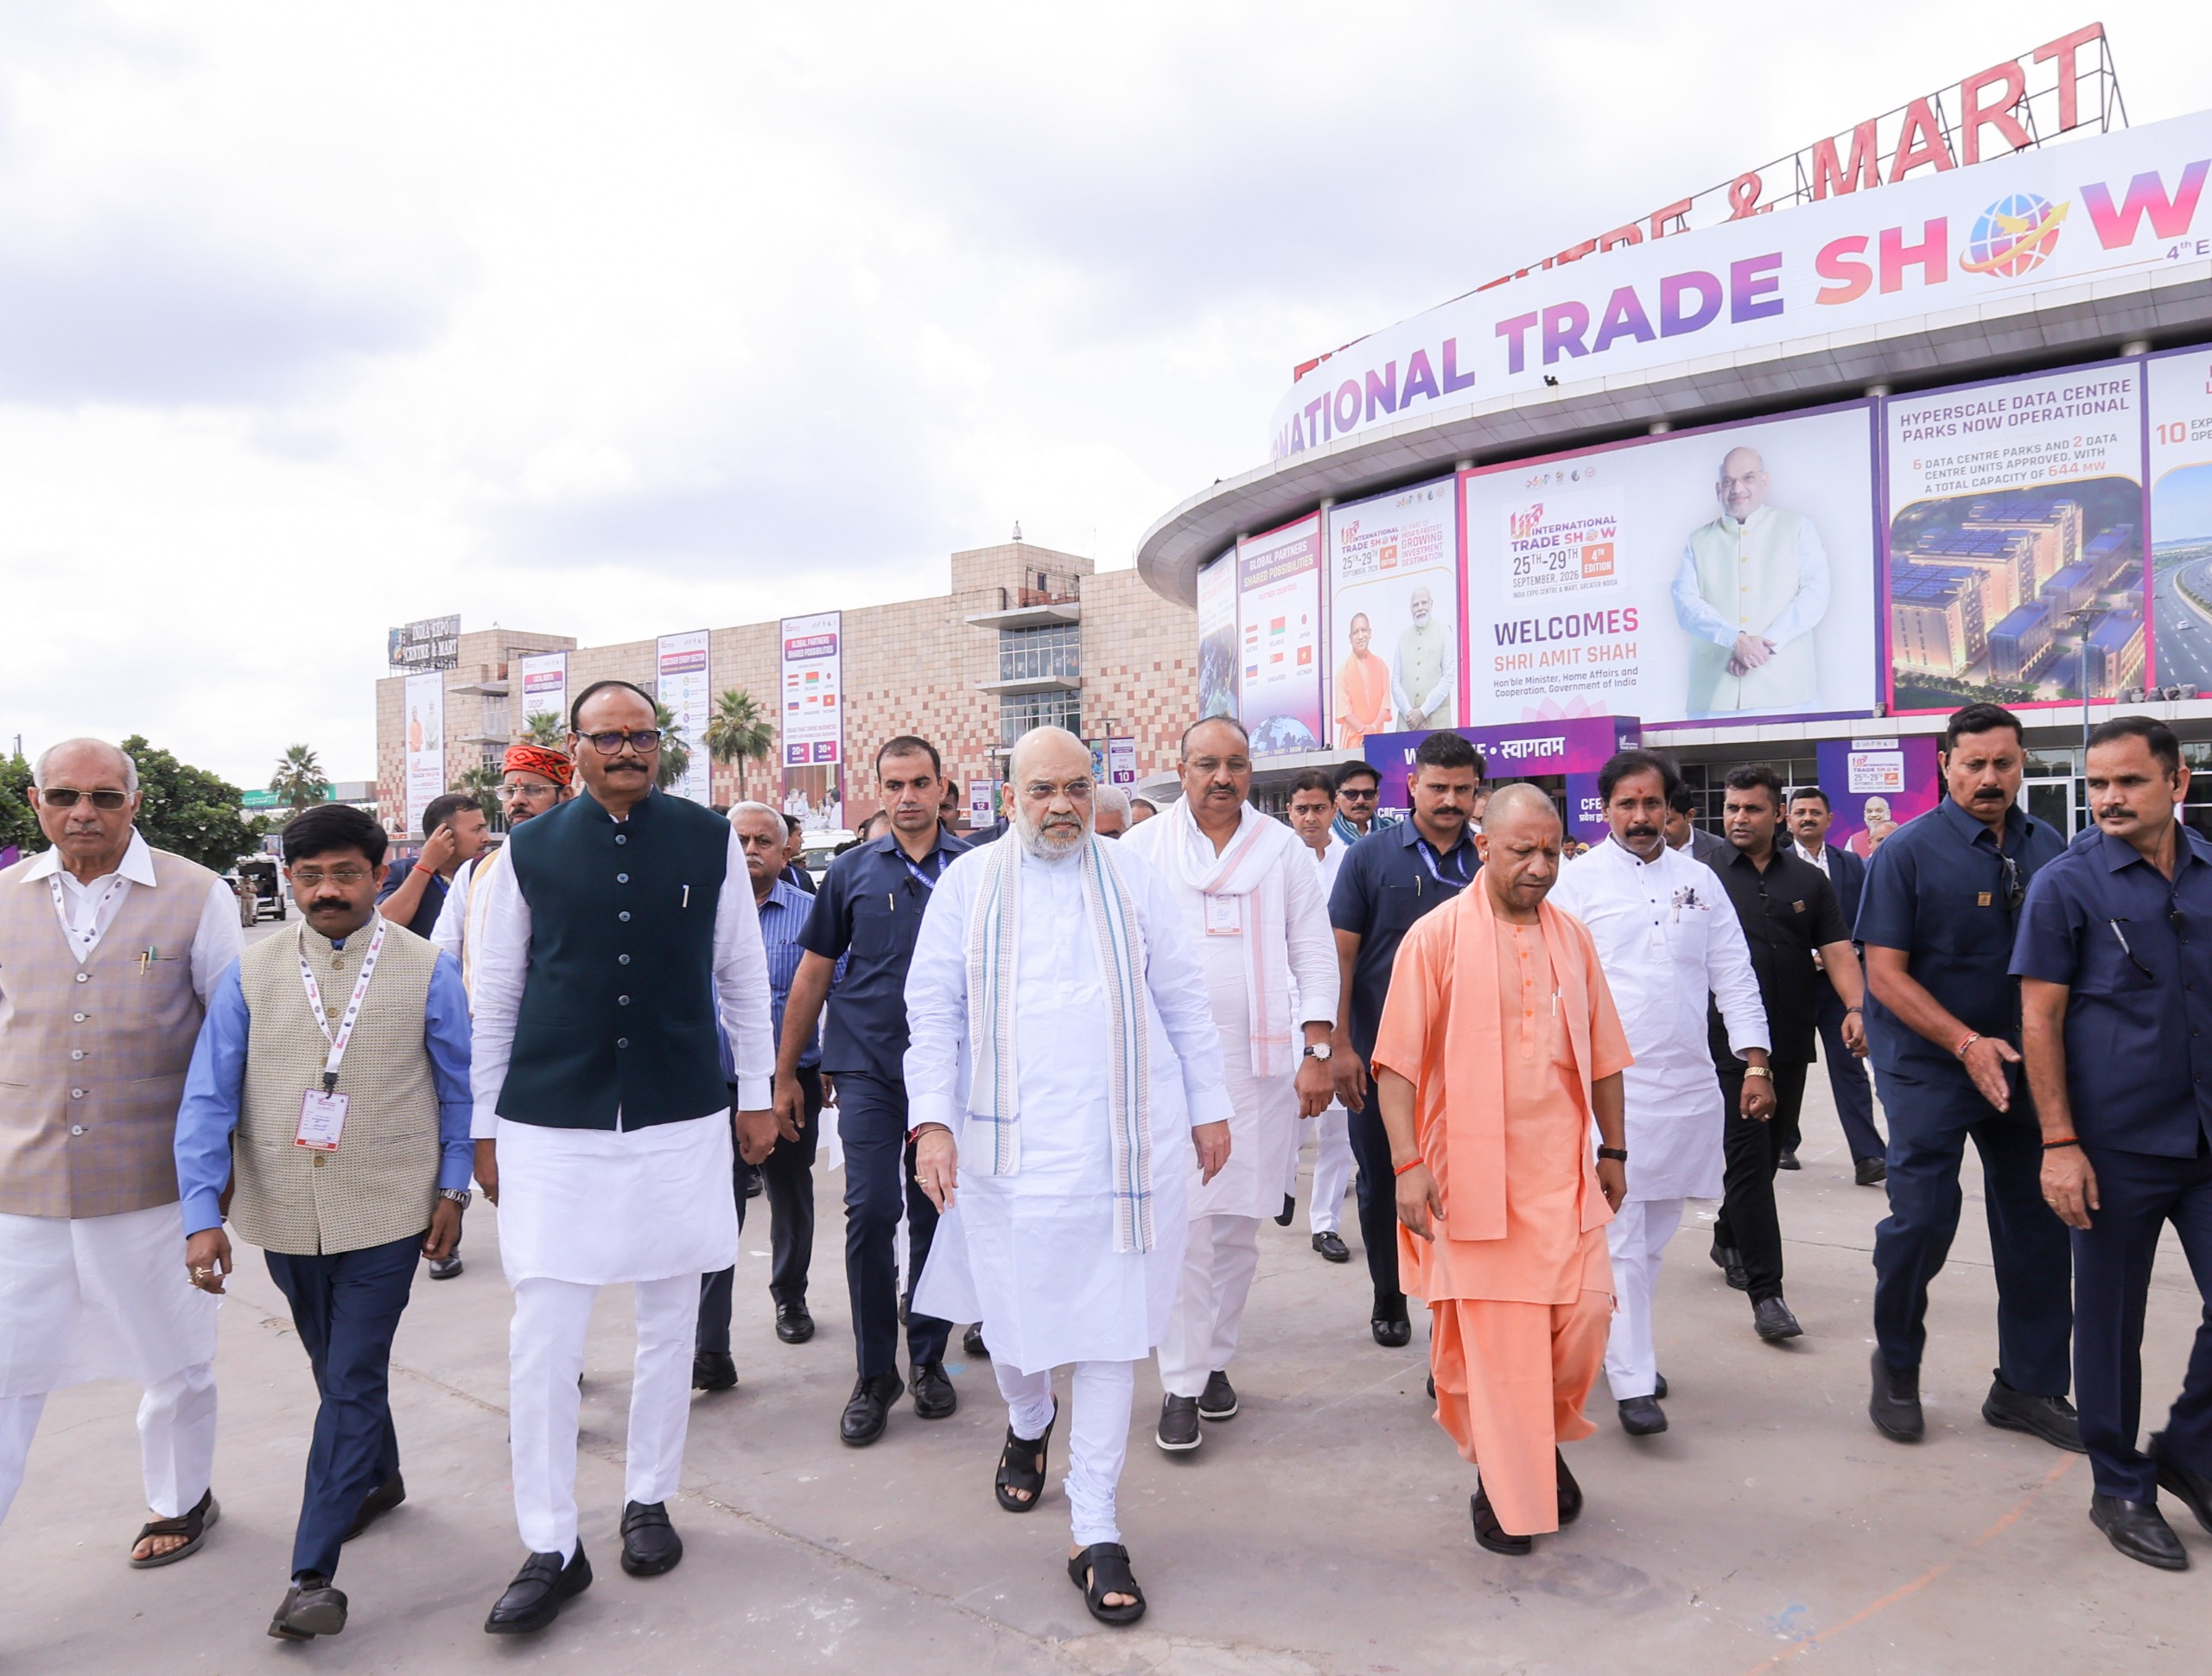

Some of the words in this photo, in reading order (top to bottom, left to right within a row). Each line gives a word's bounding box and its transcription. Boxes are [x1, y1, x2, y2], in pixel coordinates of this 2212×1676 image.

[1812, 22, 2103, 202] MART
[2166, 240, 2192, 260] 4th
[1495, 251, 1784, 375] TRADE
[1900, 398, 2006, 427] HYPERSCALE
[2012, 390, 2057, 410] DATA
[2063, 378, 2132, 402] CENTRE
[1903, 422, 1957, 442] PARKS
[1962, 416, 2003, 434] NOW
[2008, 397, 2130, 427] OPERATIONAL
[2156, 421, 2187, 446] 10
[1912, 459, 1923, 471] 6
[1925, 456, 1954, 469] DATA
[1956, 450, 1999, 465] CENTRE
[2003, 444, 2042, 458] PARKS
[2045, 440, 2070, 452] AND
[2073, 435, 2082, 448] 2
[2086, 433, 2118, 446] DATA
[1924, 467, 1967, 480] CENTRE
[1970, 461, 2004, 474] UNITS
[2006, 453, 2071, 470] APPROVED,
[2074, 448, 2106, 460] WITH
[1924, 484, 1932, 493] A
[1936, 479, 1969, 492] TOTAL
[1972, 472, 2027, 489] CAPACITY
[2031, 469, 2045, 479] OF
[2049, 462, 2080, 477] 644
[2082, 461, 2107, 473] MW
[1353, 527, 1399, 543] INTERNATIONAL
[1532, 516, 1618, 536] INTERNATIONAL
[1342, 542, 1369, 554] TRADE
[1402, 531, 1443, 549] GROWING
[1511, 535, 1560, 552] TRADE
[1249, 554, 1273, 571] GLOBAL
[1274, 541, 1307, 562] PARTNERS
[1402, 543, 1443, 558] INVESTMENT
[1402, 551, 1443, 567] DESTINATION
[1244, 570, 1268, 587] SHARED
[1269, 554, 1313, 580] POSSIBILITIES
[1584, 561, 1611, 574] EDITION
[1513, 574, 1557, 588] SEPTEMBER,
[1560, 570, 1580, 582] 2026
[1540, 587, 1557, 596] CENTRE
[1580, 581, 1601, 590] GREATER
[1603, 579, 1618, 587] NOIDA
[432, 620, 450, 638] EXPO
[1494, 607, 1638, 646] WELCOMES
[437, 638, 457, 657] MART
[1494, 652, 1533, 672] SHRI
[1539, 647, 1581, 668] AMIT
[1587, 642, 1637, 663] SHAH
[1525, 674, 1560, 686] Minister,
[1563, 672, 1587, 682] Home
[1590, 669, 1618, 679] Affairs
[1621, 666, 1638, 676] and
[1495, 685, 1547, 698] Cooperation,
[1548, 682, 1600, 694] Government
[1603, 679, 1611, 688] of
[1614, 677, 1637, 687] India
[791, 746, 804, 755] 20+
[817, 744, 832, 753] 30+
[1118, 771, 1130, 783] 10
